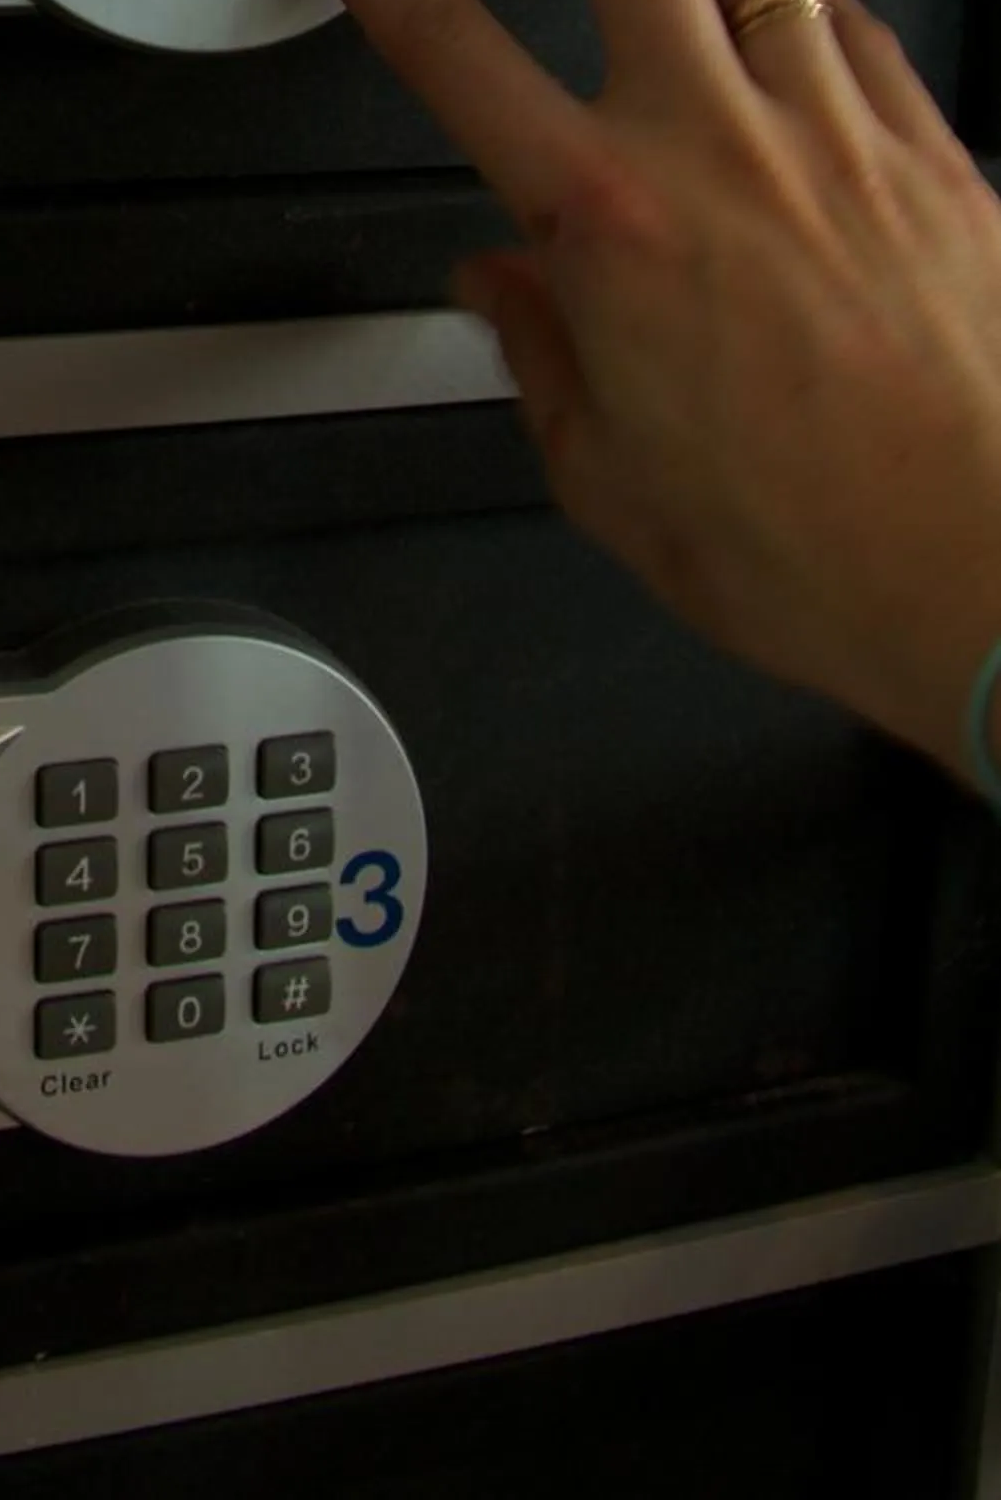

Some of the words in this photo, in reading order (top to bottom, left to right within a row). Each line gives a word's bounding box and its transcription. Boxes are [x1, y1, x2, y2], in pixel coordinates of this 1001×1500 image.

[71, 779, 87, 815] 1
[181, 766, 204, 801] 2
[290, 752, 312, 785] 3
[65, 857, 93, 893] 4
[181, 842, 204, 877] 5
[289, 828, 312, 861] 6
[336, 850, 405, 948] 3
[68, 934, 92, 970] 7
[179, 920, 203, 954] 8
[287, 904, 310, 937] 9
[177, 996, 201, 1030] 0
[283, 977, 310, 1012] #
[258, 1033, 319, 1061] Lock
[40, 1069, 111, 1096] Clear
